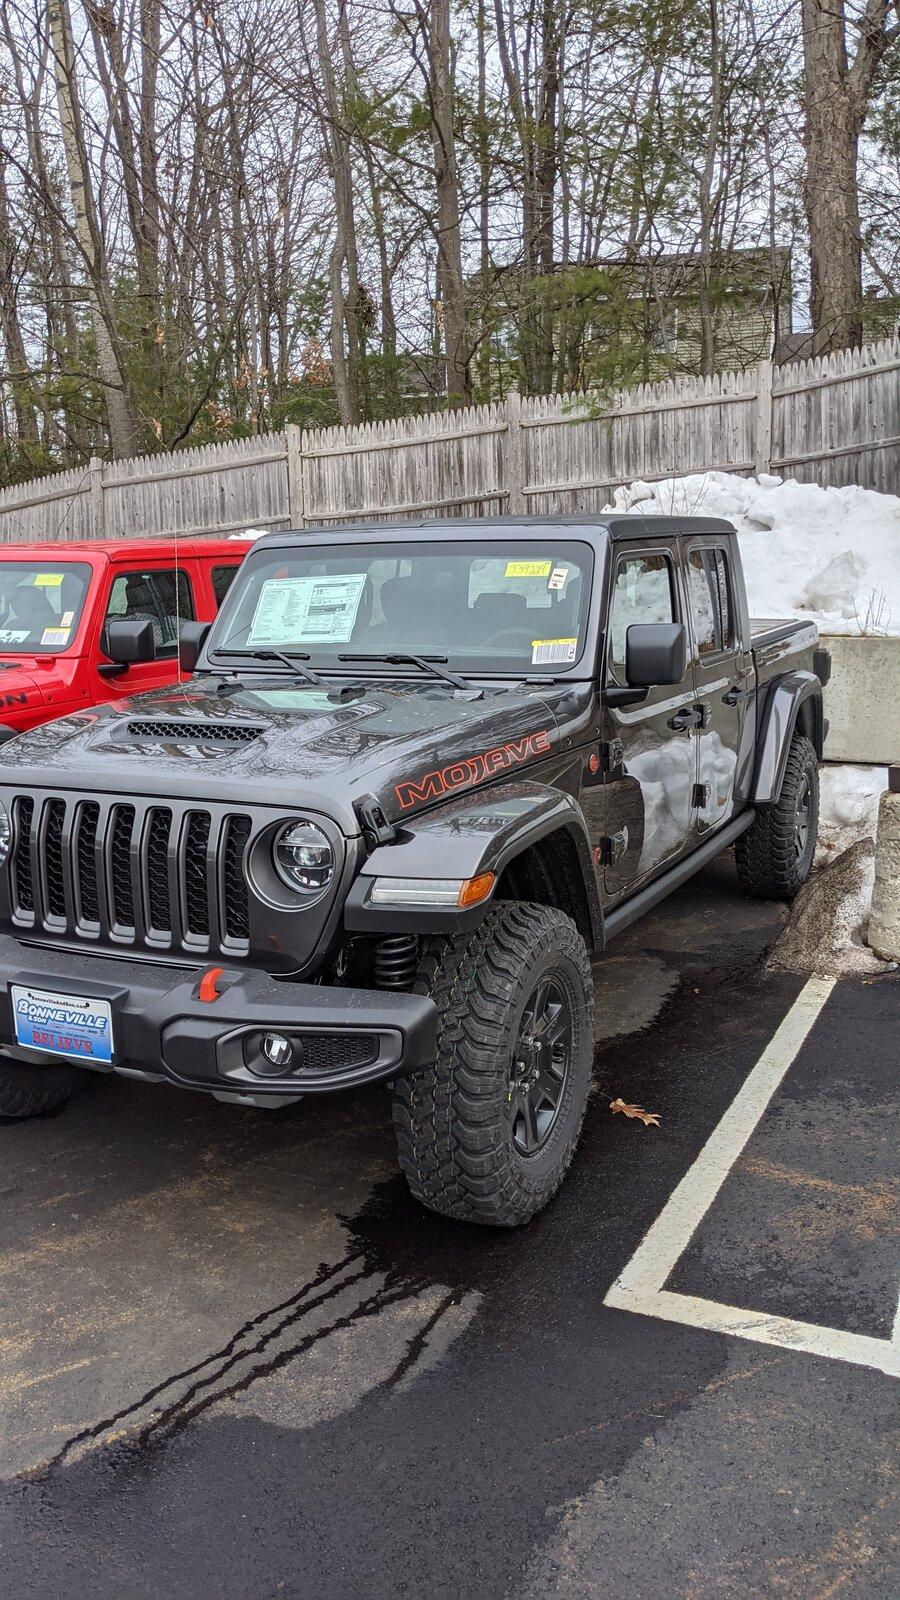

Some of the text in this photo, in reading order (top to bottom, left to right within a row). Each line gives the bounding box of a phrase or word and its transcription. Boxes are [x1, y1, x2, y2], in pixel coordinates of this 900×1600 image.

[395, 730, 551, 809] MOJAVE
[17, 999, 107, 1029] BONNEVILLE
[32, 1030, 94, 1054] BELIEVE
